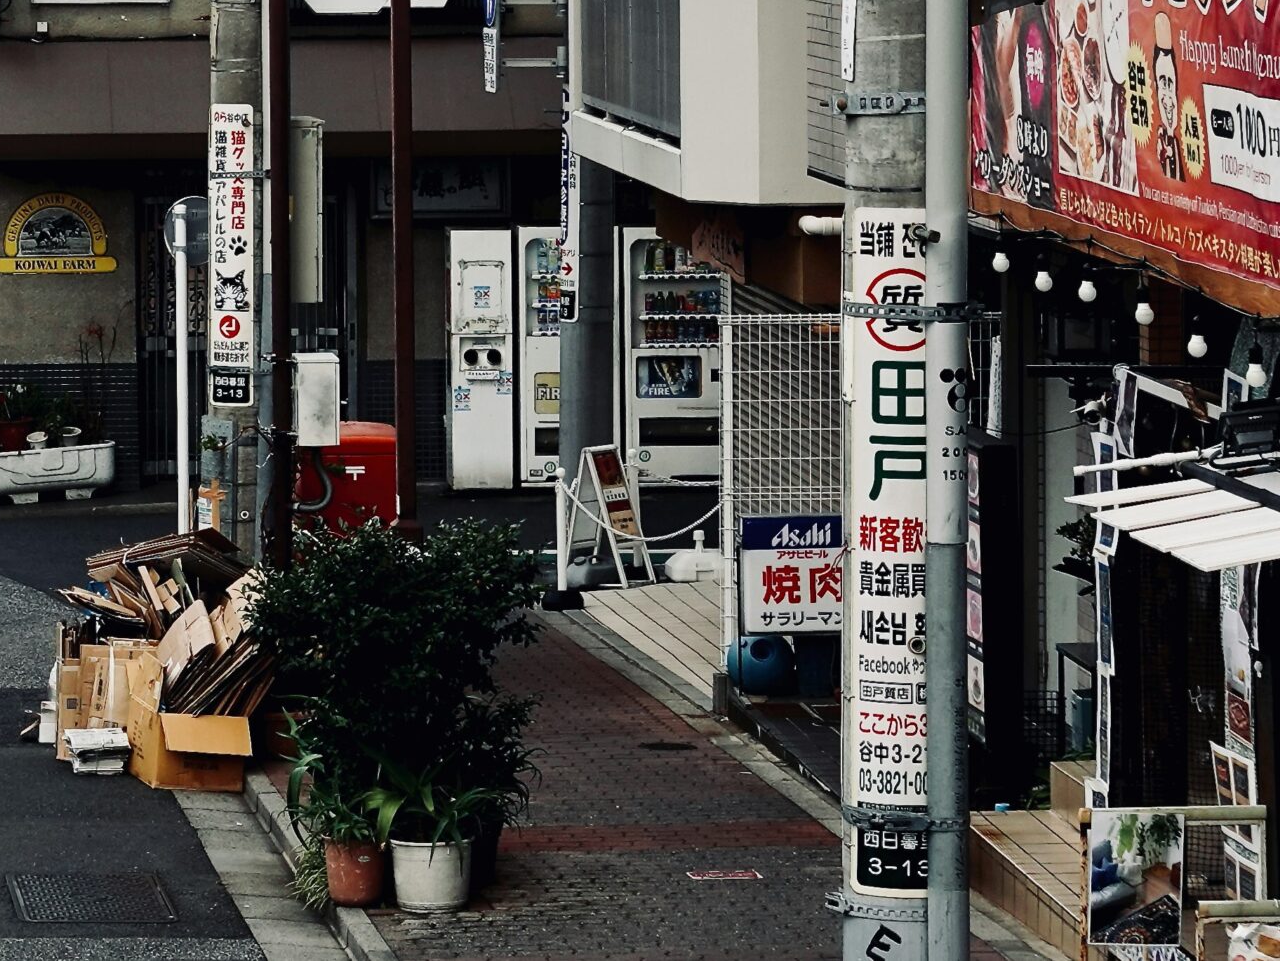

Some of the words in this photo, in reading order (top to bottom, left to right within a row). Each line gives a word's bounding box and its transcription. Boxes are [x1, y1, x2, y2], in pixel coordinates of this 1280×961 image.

[1025, 45, 1044, 83] 毎晩
[1180, 30, 1216, 74] Happy
[1219, 36, 1252, 72] Lunch
[1128, 61, 1146, 94] 谷中
[1130, 95, 1149, 128] 名物
[1017, 116, 1048, 158] 8時より
[1185, 114, 1200, 141] 人気
[1186, 144, 1201, 165] No.1
[7, 203, 34, 242] GENUINE
[38, 196, 66, 206] DAIRY
[70, 198, 104, 241] PRODUCTS
[859, 221, 895, 257] 当铺
[15, 259, 59, 271] KOIWAI
[62, 259, 96, 270] FARM
[216, 389, 243, 398] 3-13
[536, 387, 560, 400] FIR
[649, 387, 670, 396] FIRE
[869, 360, 926, 501] 田戸
[772, 522, 831, 547] Asahi
[859, 514, 926, 553] 新客歓
[777, 550, 828, 560] アサヒビール
[762, 563, 842, 605] 焼肉
[760, 611, 842, 626] サラリーマン
[859, 610, 907, 646] 새손님
[859, 654, 911, 675] Facebook
[862, 684, 910, 701] 田戸質店
[859, 741, 927, 764] 谷中3-2
